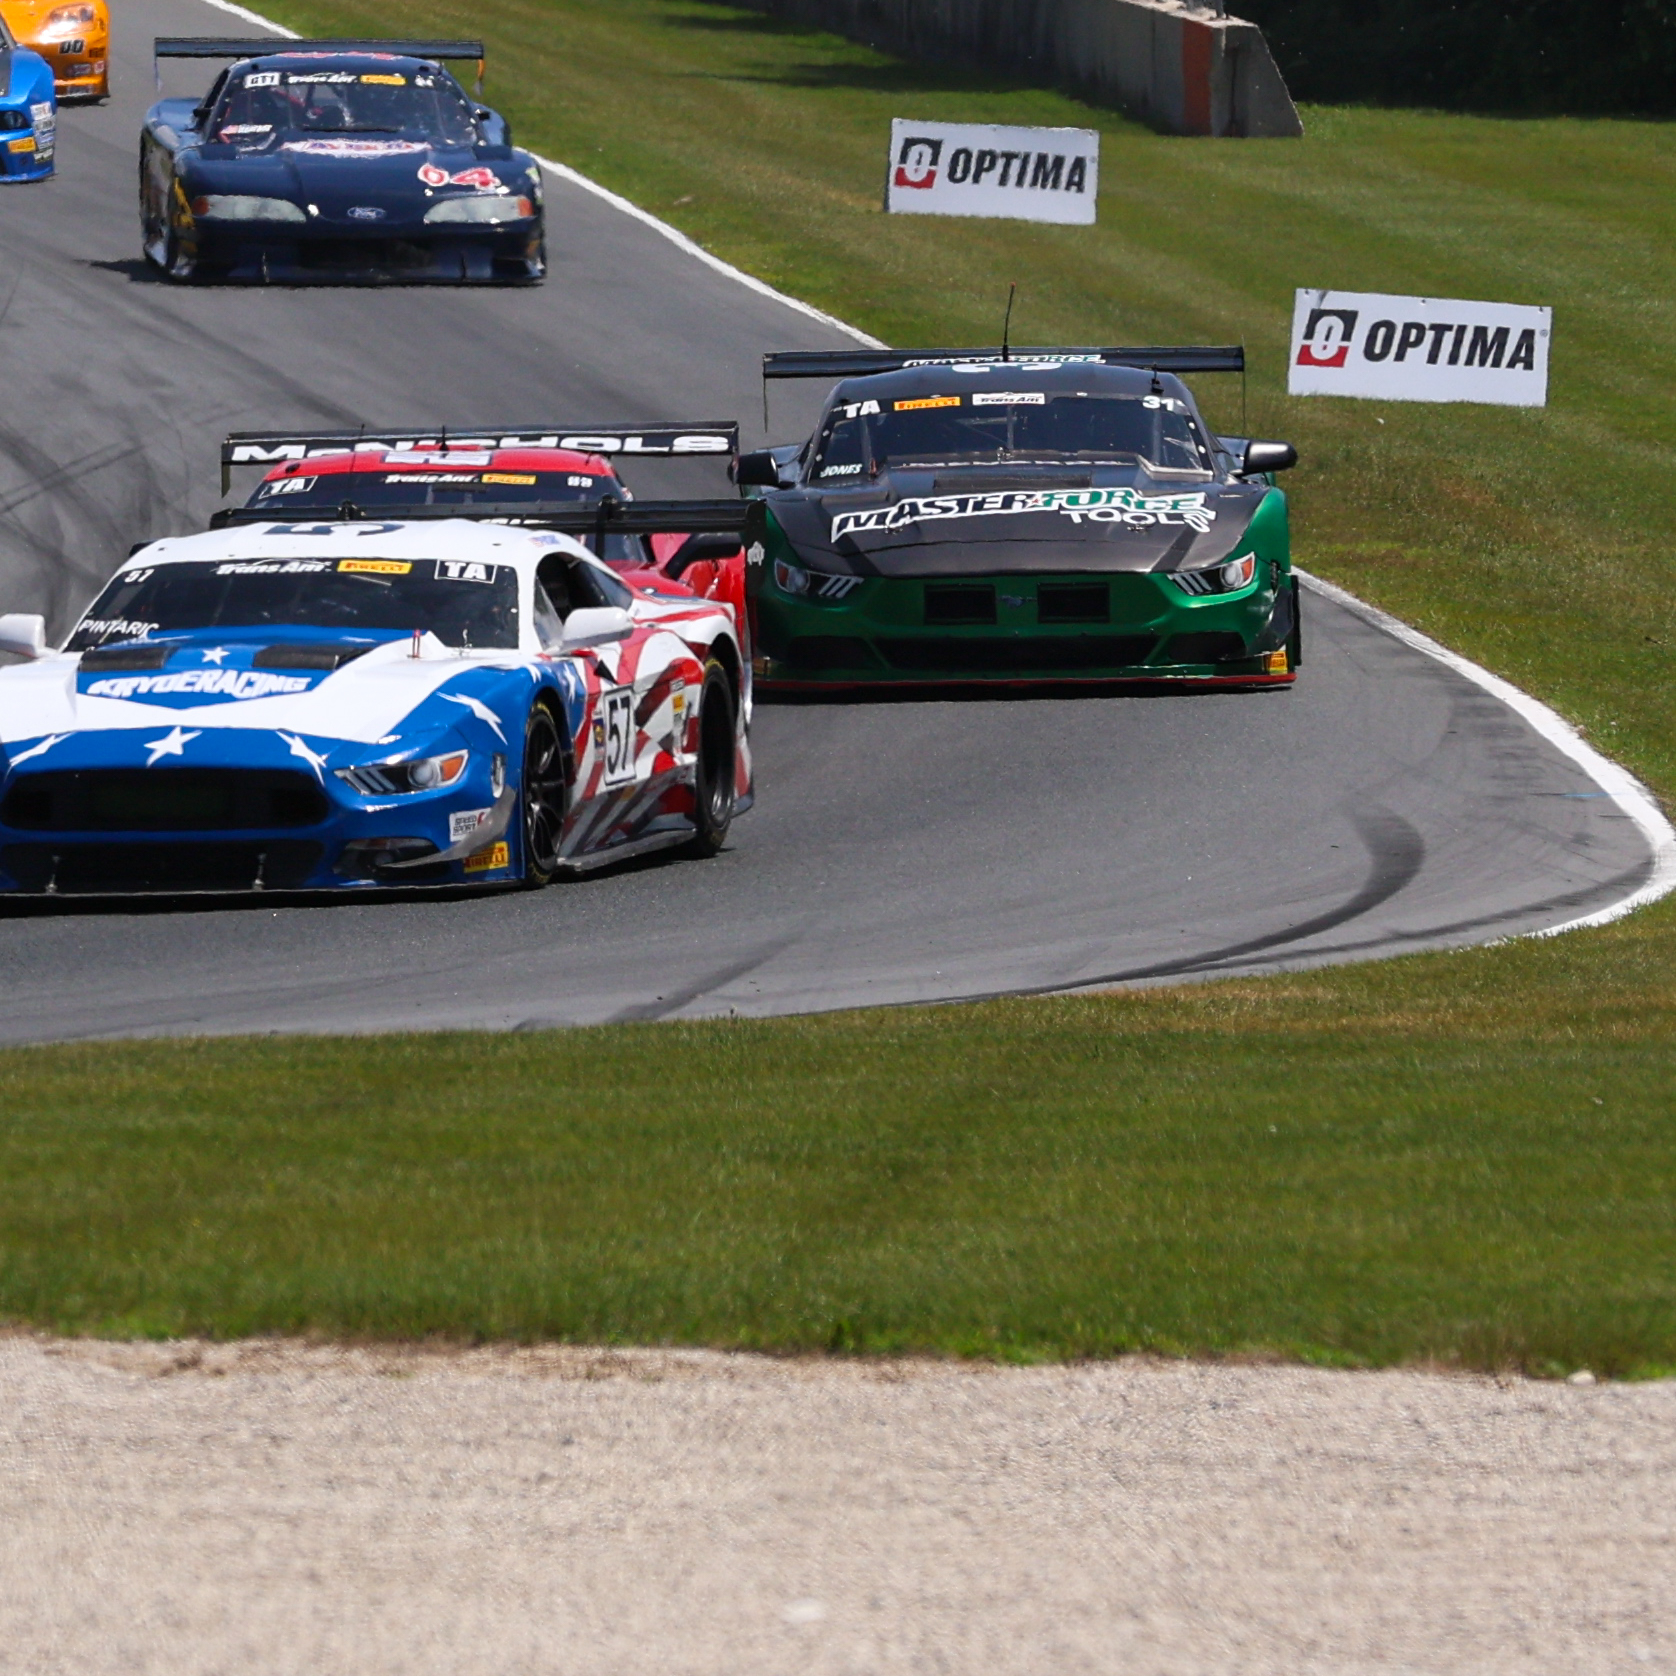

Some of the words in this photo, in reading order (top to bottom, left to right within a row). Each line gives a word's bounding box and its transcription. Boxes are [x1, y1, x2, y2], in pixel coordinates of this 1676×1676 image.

[418, 163, 500, 192] 04
[947, 148, 1087, 194] OPTIMA
[1362, 319, 1536, 371] OPTIMA
[844, 399, 880, 419] TA
[896, 397, 958, 410] PIRELLI
[1142, 395, 1174, 411] 31
[820, 463, 863, 477] JONES
[270, 478, 307, 494] TA
[1059, 508, 1210, 533] TOOLS
[124, 568, 155, 583] 57
[215, 562, 279, 575] Trans
[343, 562, 407, 573] PIRELLI
[445, 561, 488, 581] TA
[77, 619, 159, 639] PINTARIC
[607, 694, 632, 778] 57
